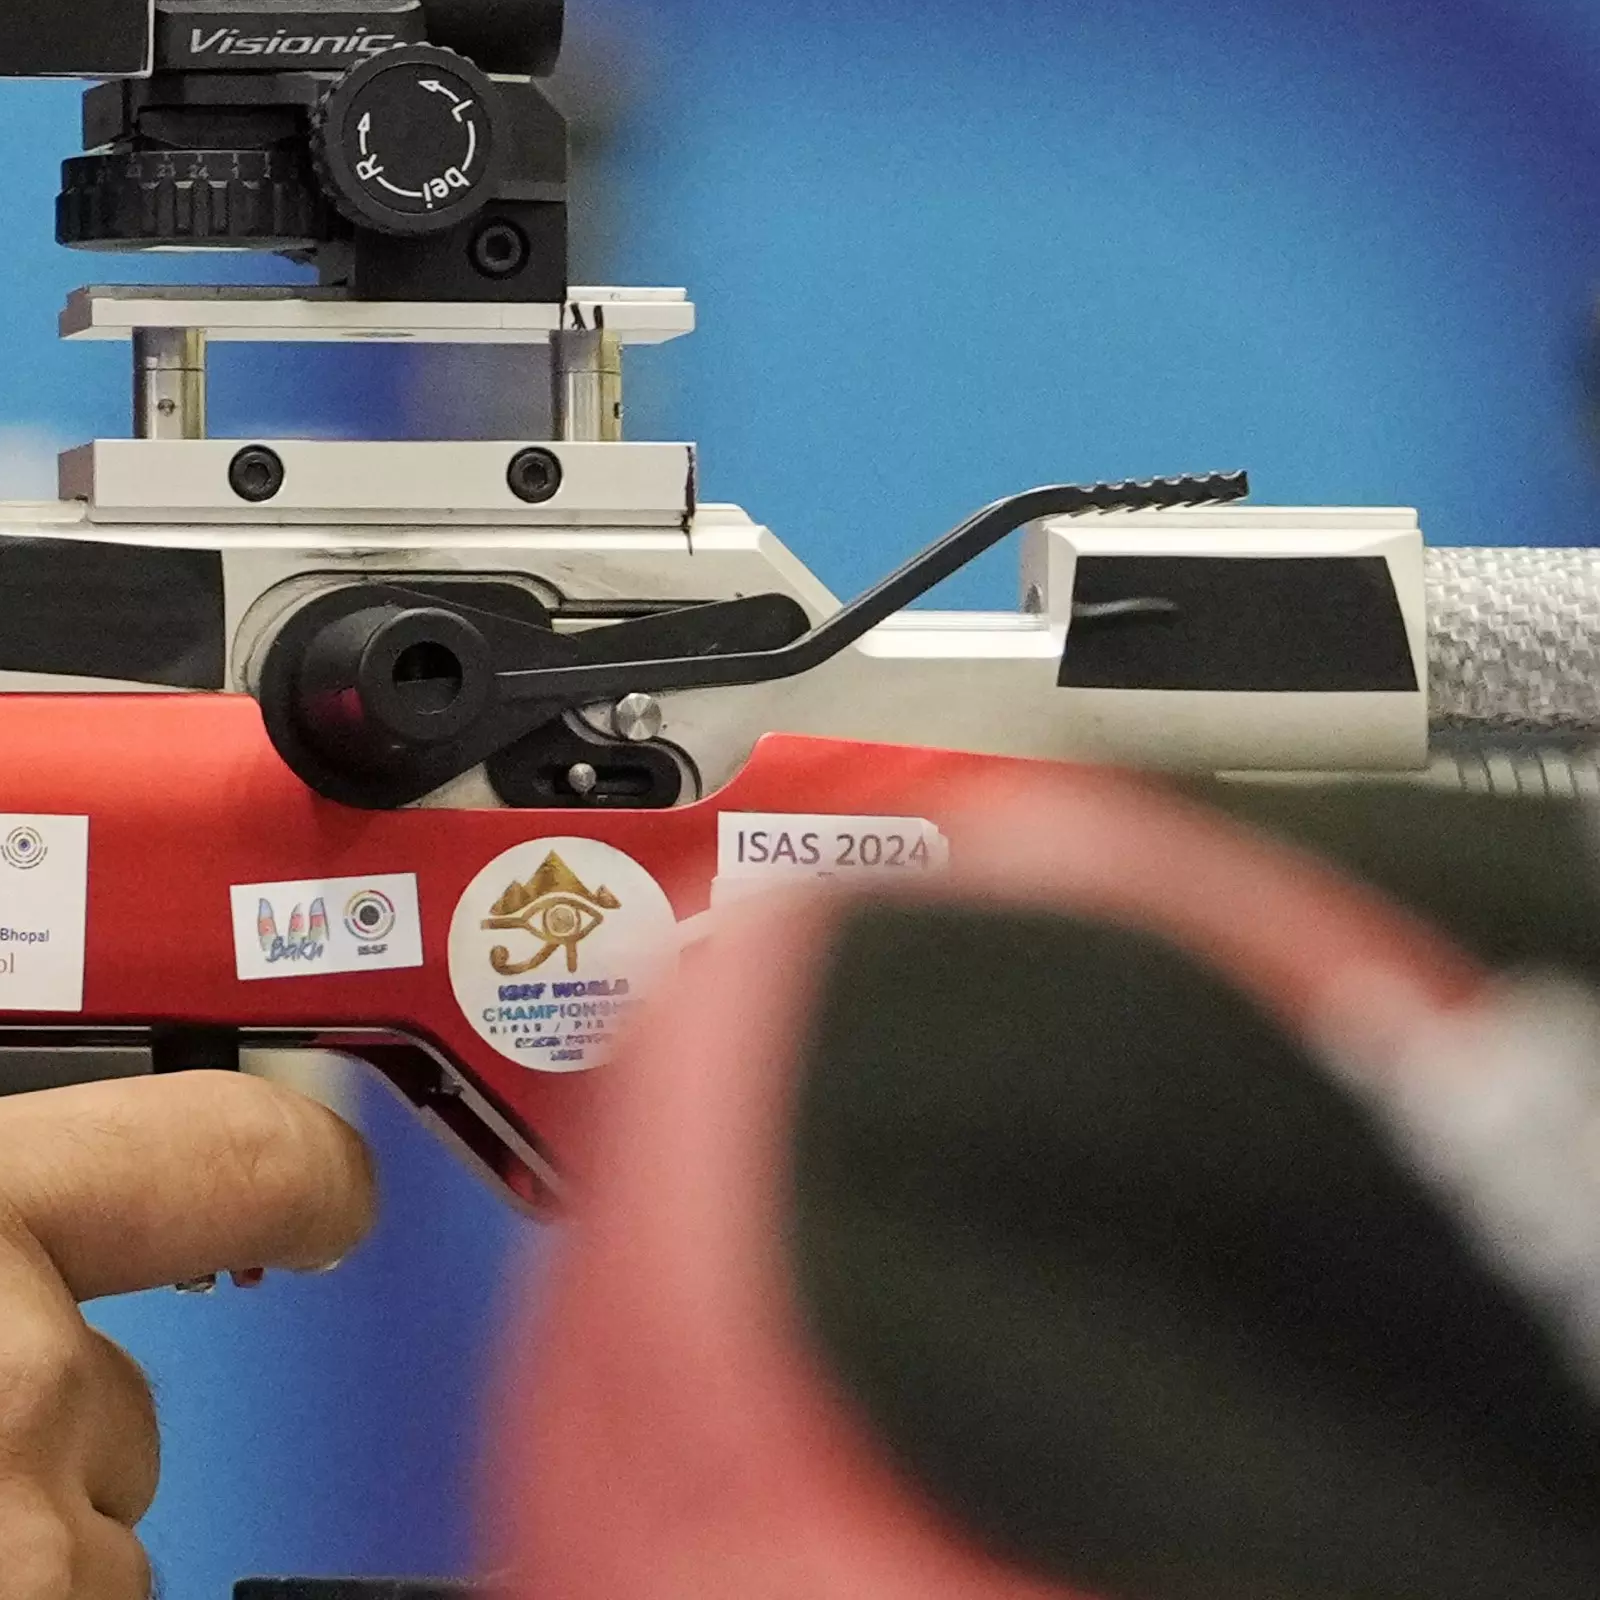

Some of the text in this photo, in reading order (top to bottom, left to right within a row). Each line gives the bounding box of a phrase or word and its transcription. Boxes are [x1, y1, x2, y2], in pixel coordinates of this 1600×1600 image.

[190, 27, 395, 55] Visionic
[355, 153, 385, 180] R
[738, 831, 930, 868] ISAS 2024
[0, 928, 50, 945] Bhopal
[497, 978, 629, 1001] ISSF WORLD
[482, 1000, 624, 1022] CHAMPIONS
